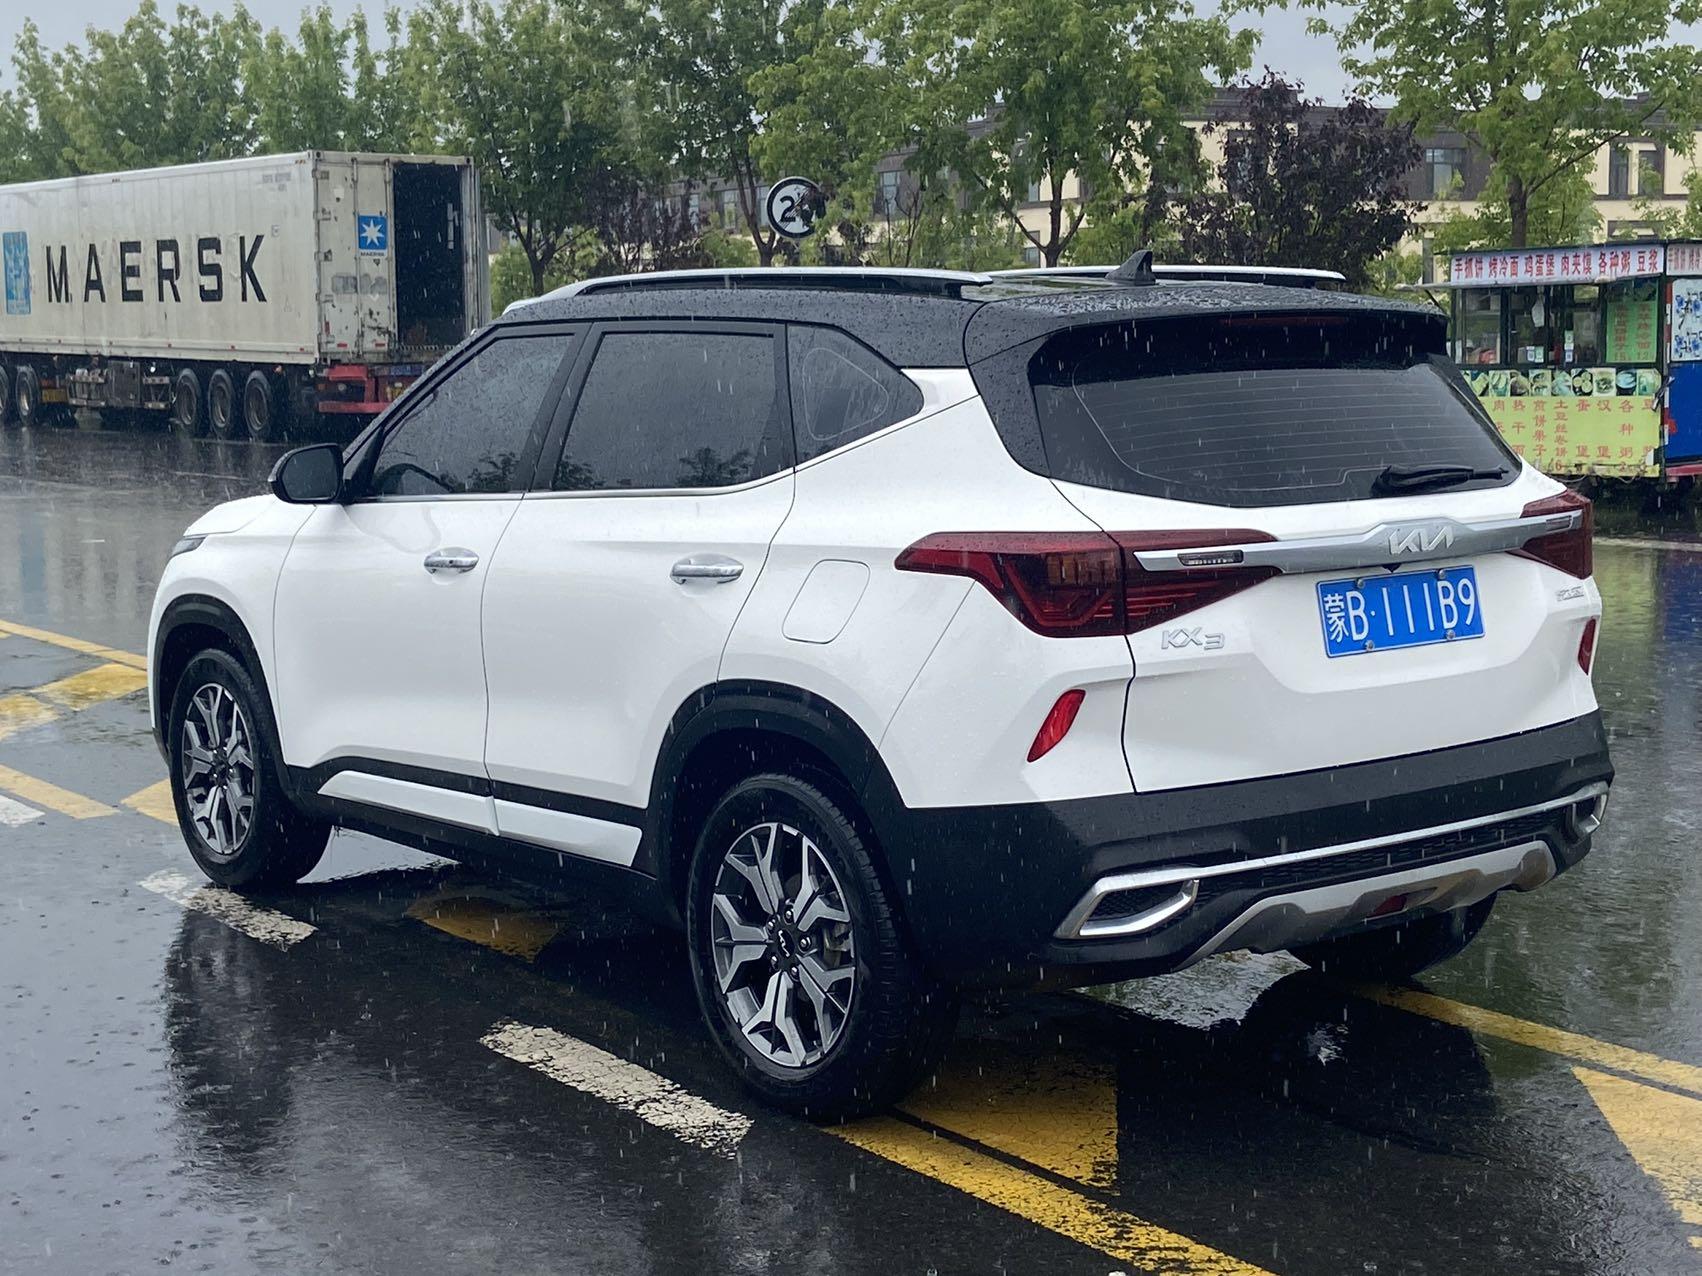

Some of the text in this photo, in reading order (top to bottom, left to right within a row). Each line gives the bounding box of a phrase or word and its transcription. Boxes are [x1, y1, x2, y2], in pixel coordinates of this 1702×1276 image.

[780, 195, 806, 222] 2
[46, 234, 267, 303] MAERSK
[1454, 256, 1483, 280] 手抓饼
[1488, 255, 1519, 278] 烤冷面
[1637, 248, 1658, 273] 豆浆
[1389, 526, 1454, 555] KIA
[1161, 627, 1225, 651] KX3
